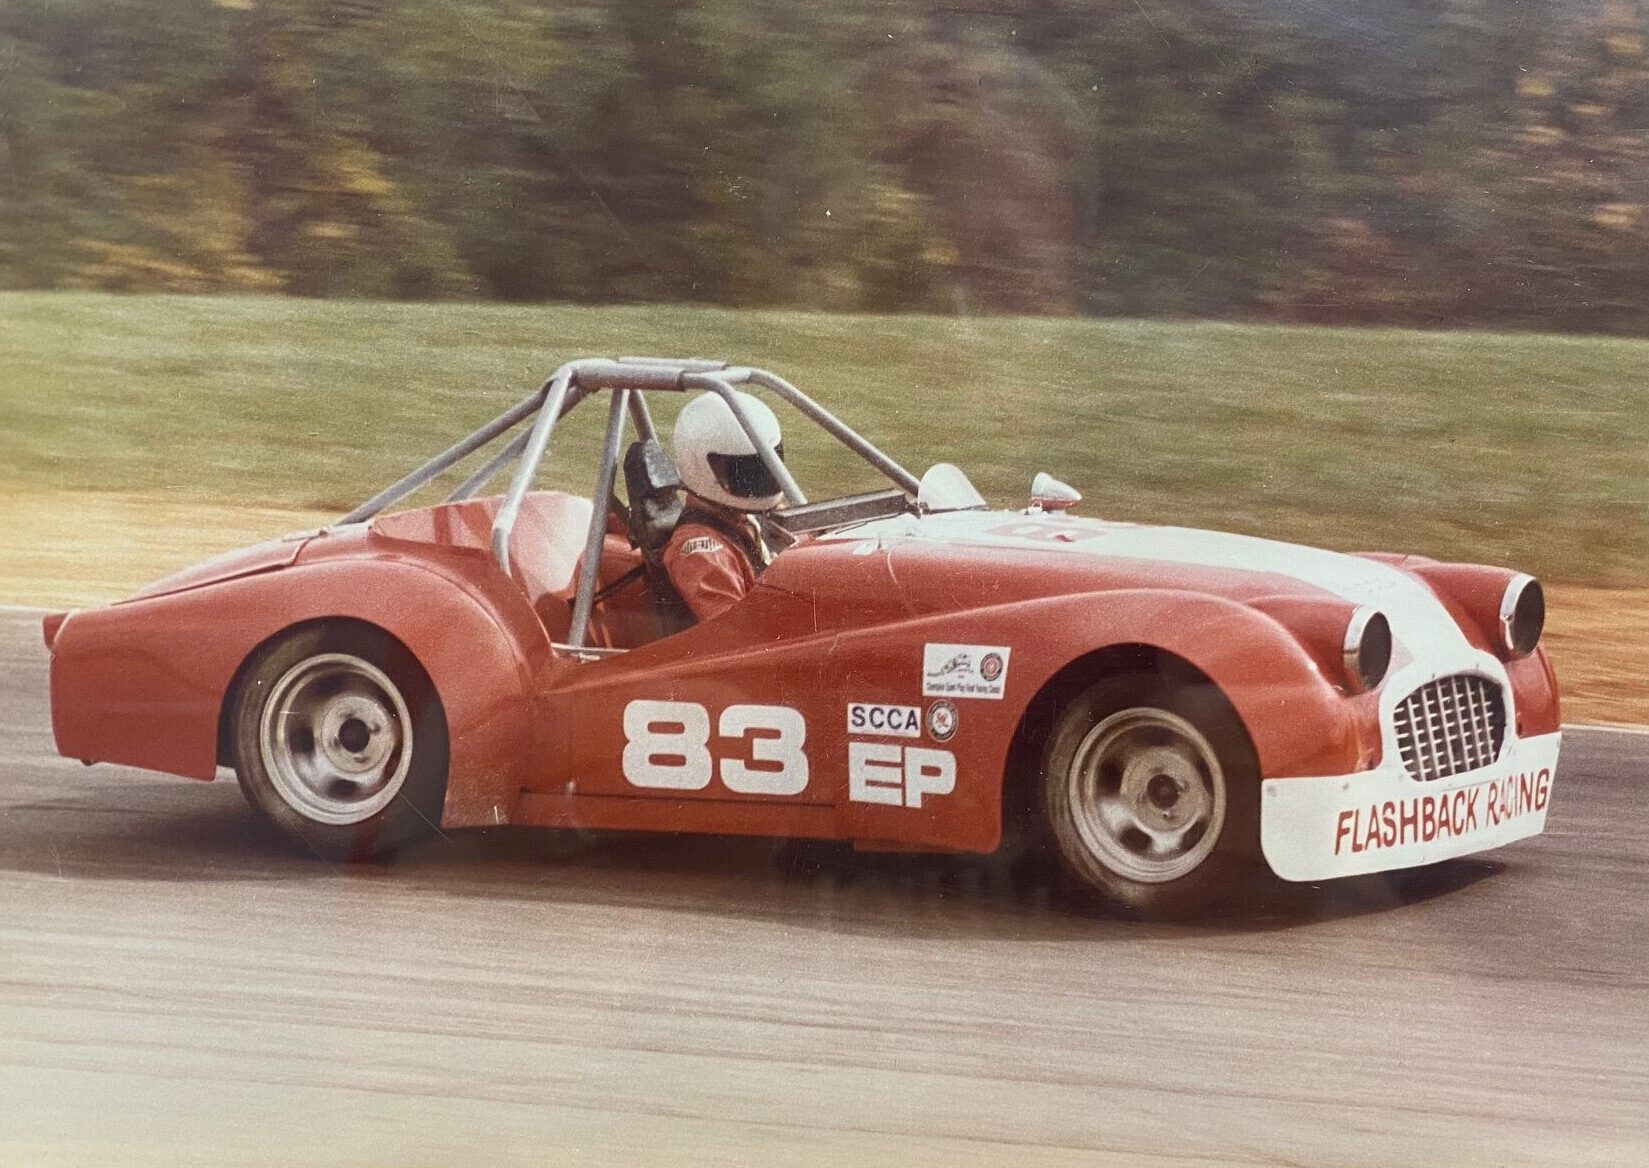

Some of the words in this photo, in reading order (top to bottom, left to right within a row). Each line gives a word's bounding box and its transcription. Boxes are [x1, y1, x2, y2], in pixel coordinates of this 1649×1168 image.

[623, 699, 809, 795] 83
[851, 705, 919, 730] SCCA
[848, 741, 957, 808] EP
[1335, 787, 1479, 855] FLASHBACK
[1486, 768, 1549, 828] RACING
